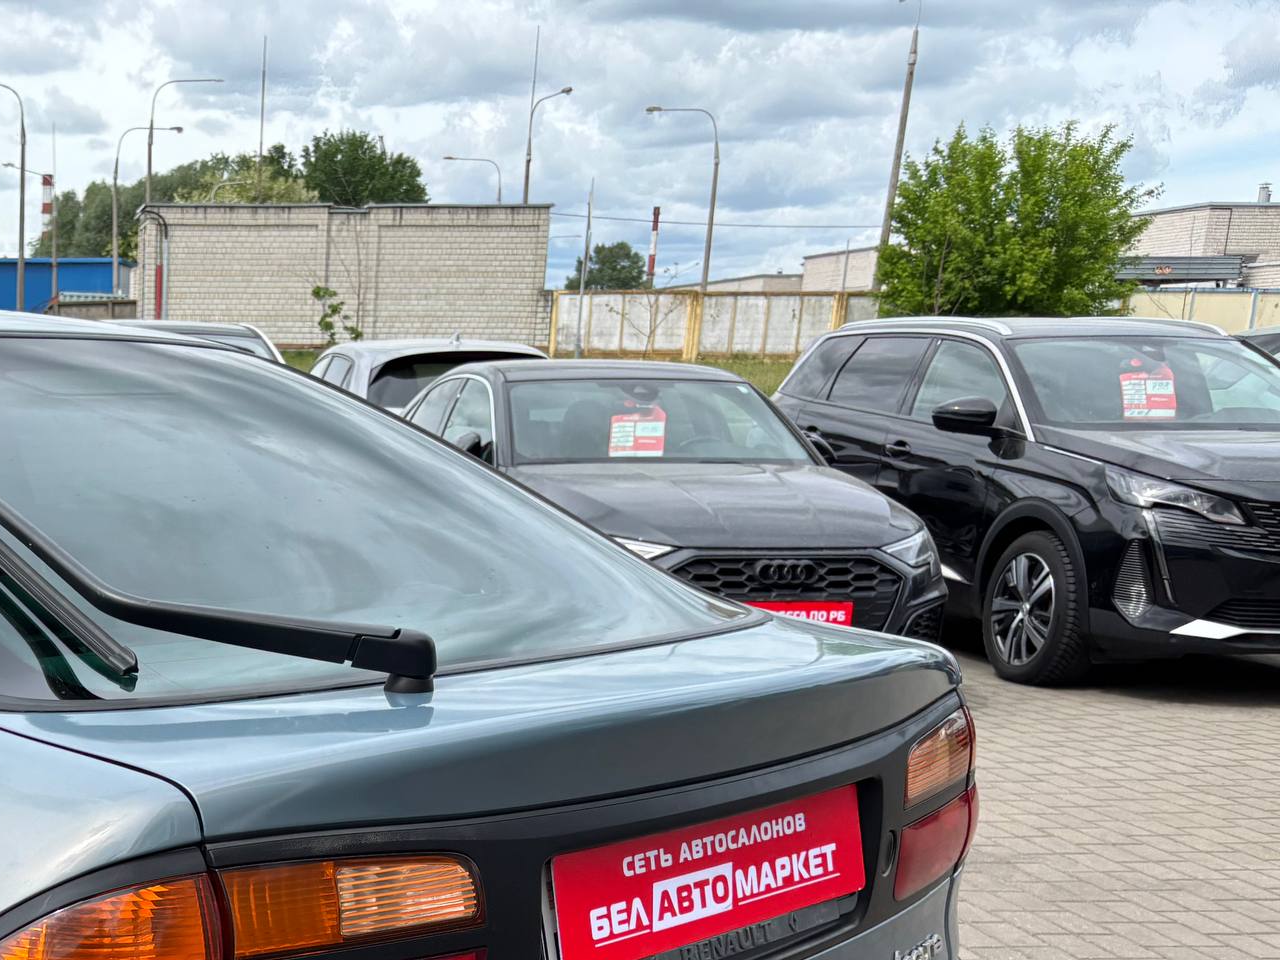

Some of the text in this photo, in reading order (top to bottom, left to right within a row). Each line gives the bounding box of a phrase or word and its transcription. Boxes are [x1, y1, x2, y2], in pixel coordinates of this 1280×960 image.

[809, 611, 827, 621] ПО
[829, 611, 846, 621] РБ
[622, 812, 806, 877] СЕТЬ АВТОСАЛОНОВ
[589, 843, 837, 940] БЕЛАВТОМАРКЕТ
